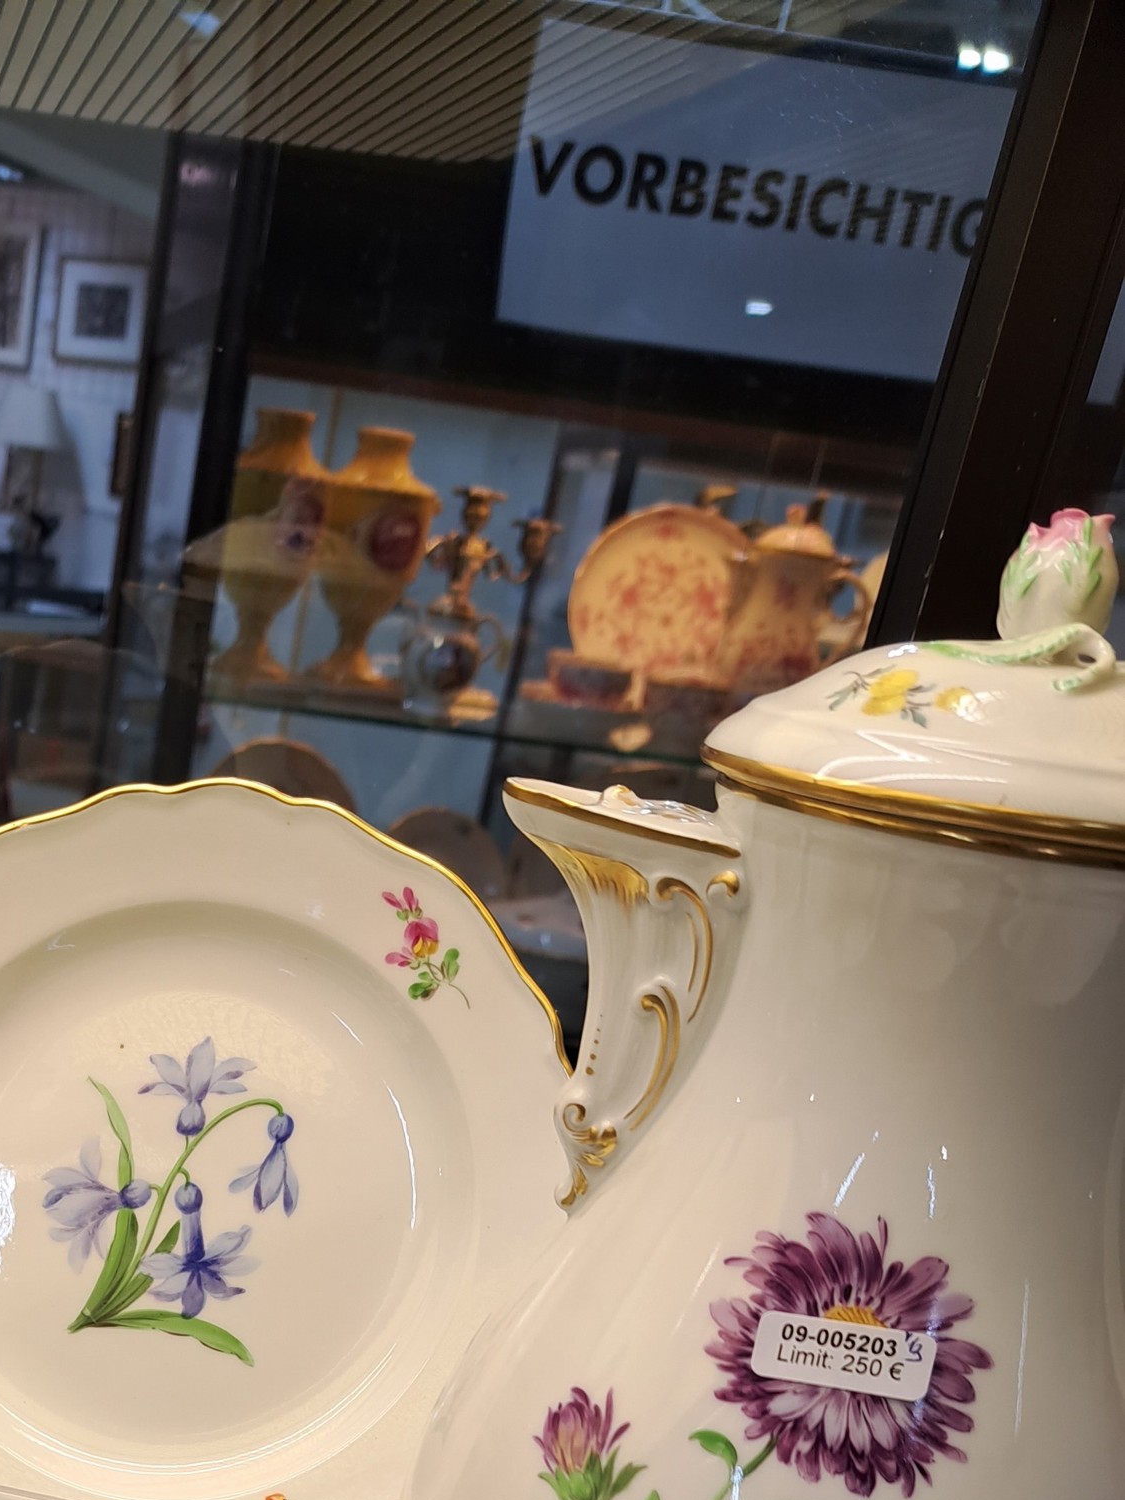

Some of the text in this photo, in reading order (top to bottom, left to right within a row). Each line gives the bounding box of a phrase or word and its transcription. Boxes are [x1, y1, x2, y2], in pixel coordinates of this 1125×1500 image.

[781, 1323, 897, 1357] 09-005203
[777, 1343, 905, 1380] Limit: 250 €
